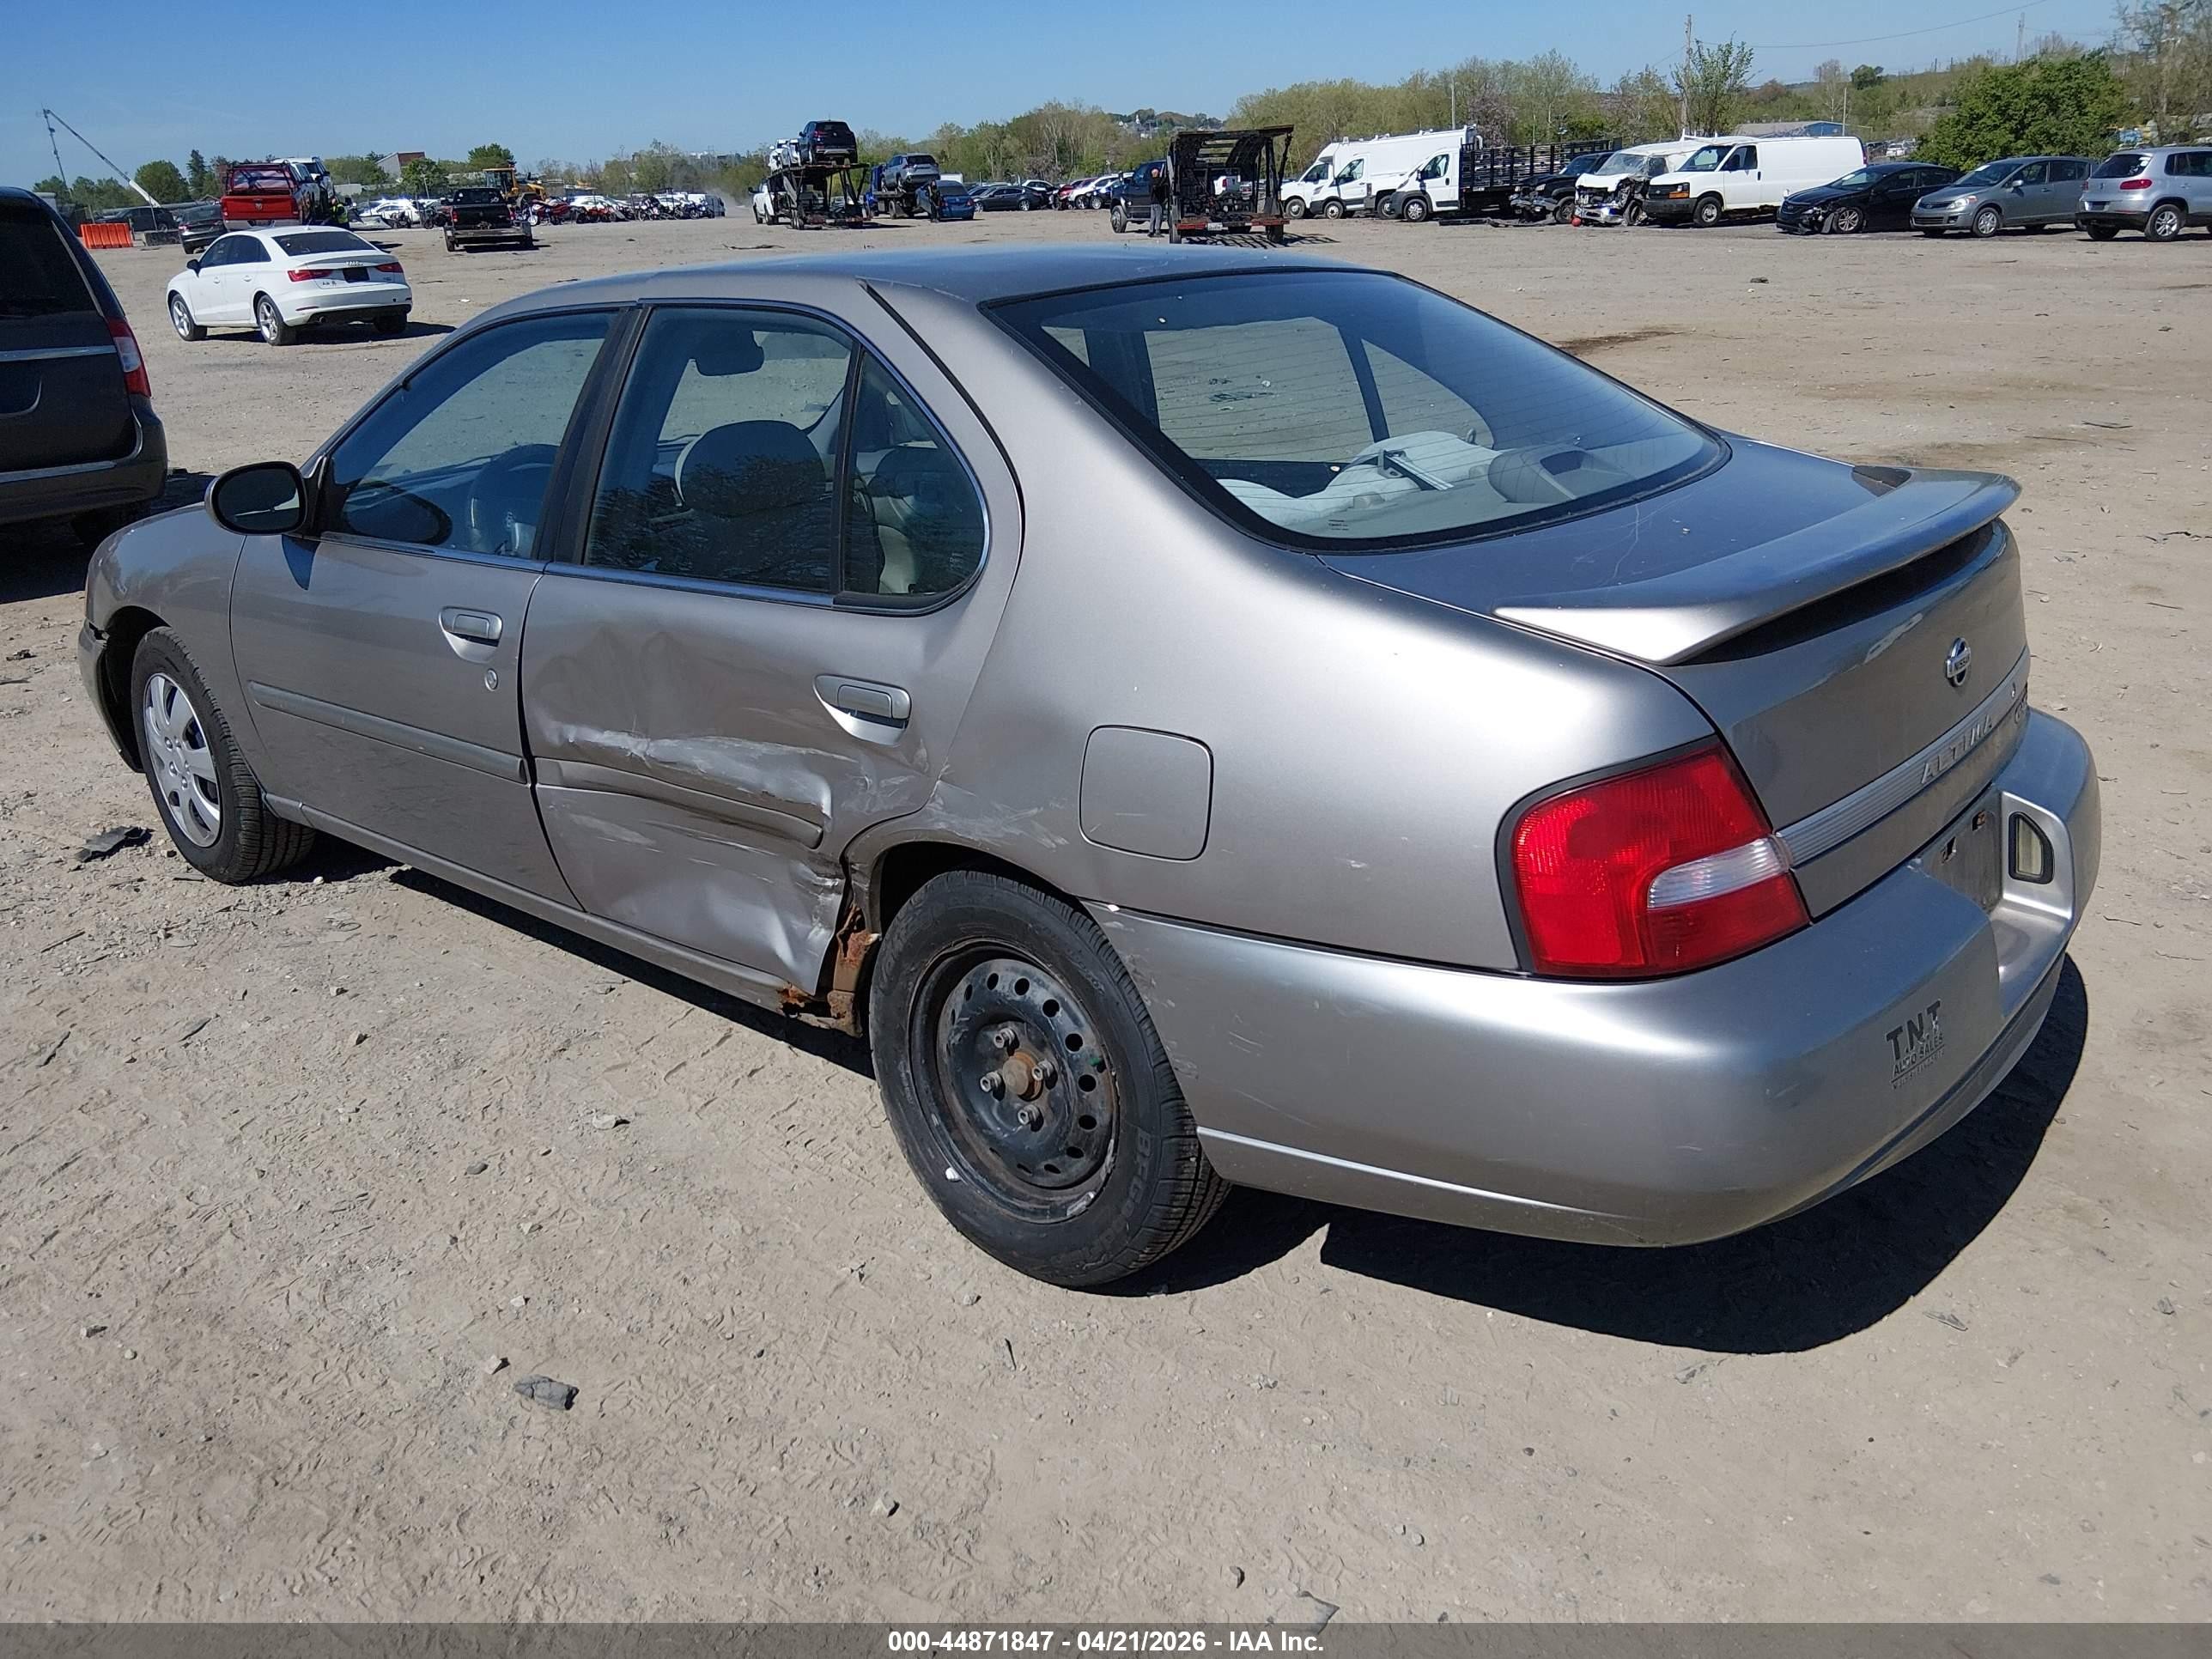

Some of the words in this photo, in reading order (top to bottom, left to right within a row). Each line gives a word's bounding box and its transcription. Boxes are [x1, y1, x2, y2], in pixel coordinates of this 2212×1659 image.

[1922, 714, 1993, 784] ALTIMA
[1894, 1052, 1917, 1075] AUTO
[1918, 1033, 1943, 1060] SALES
